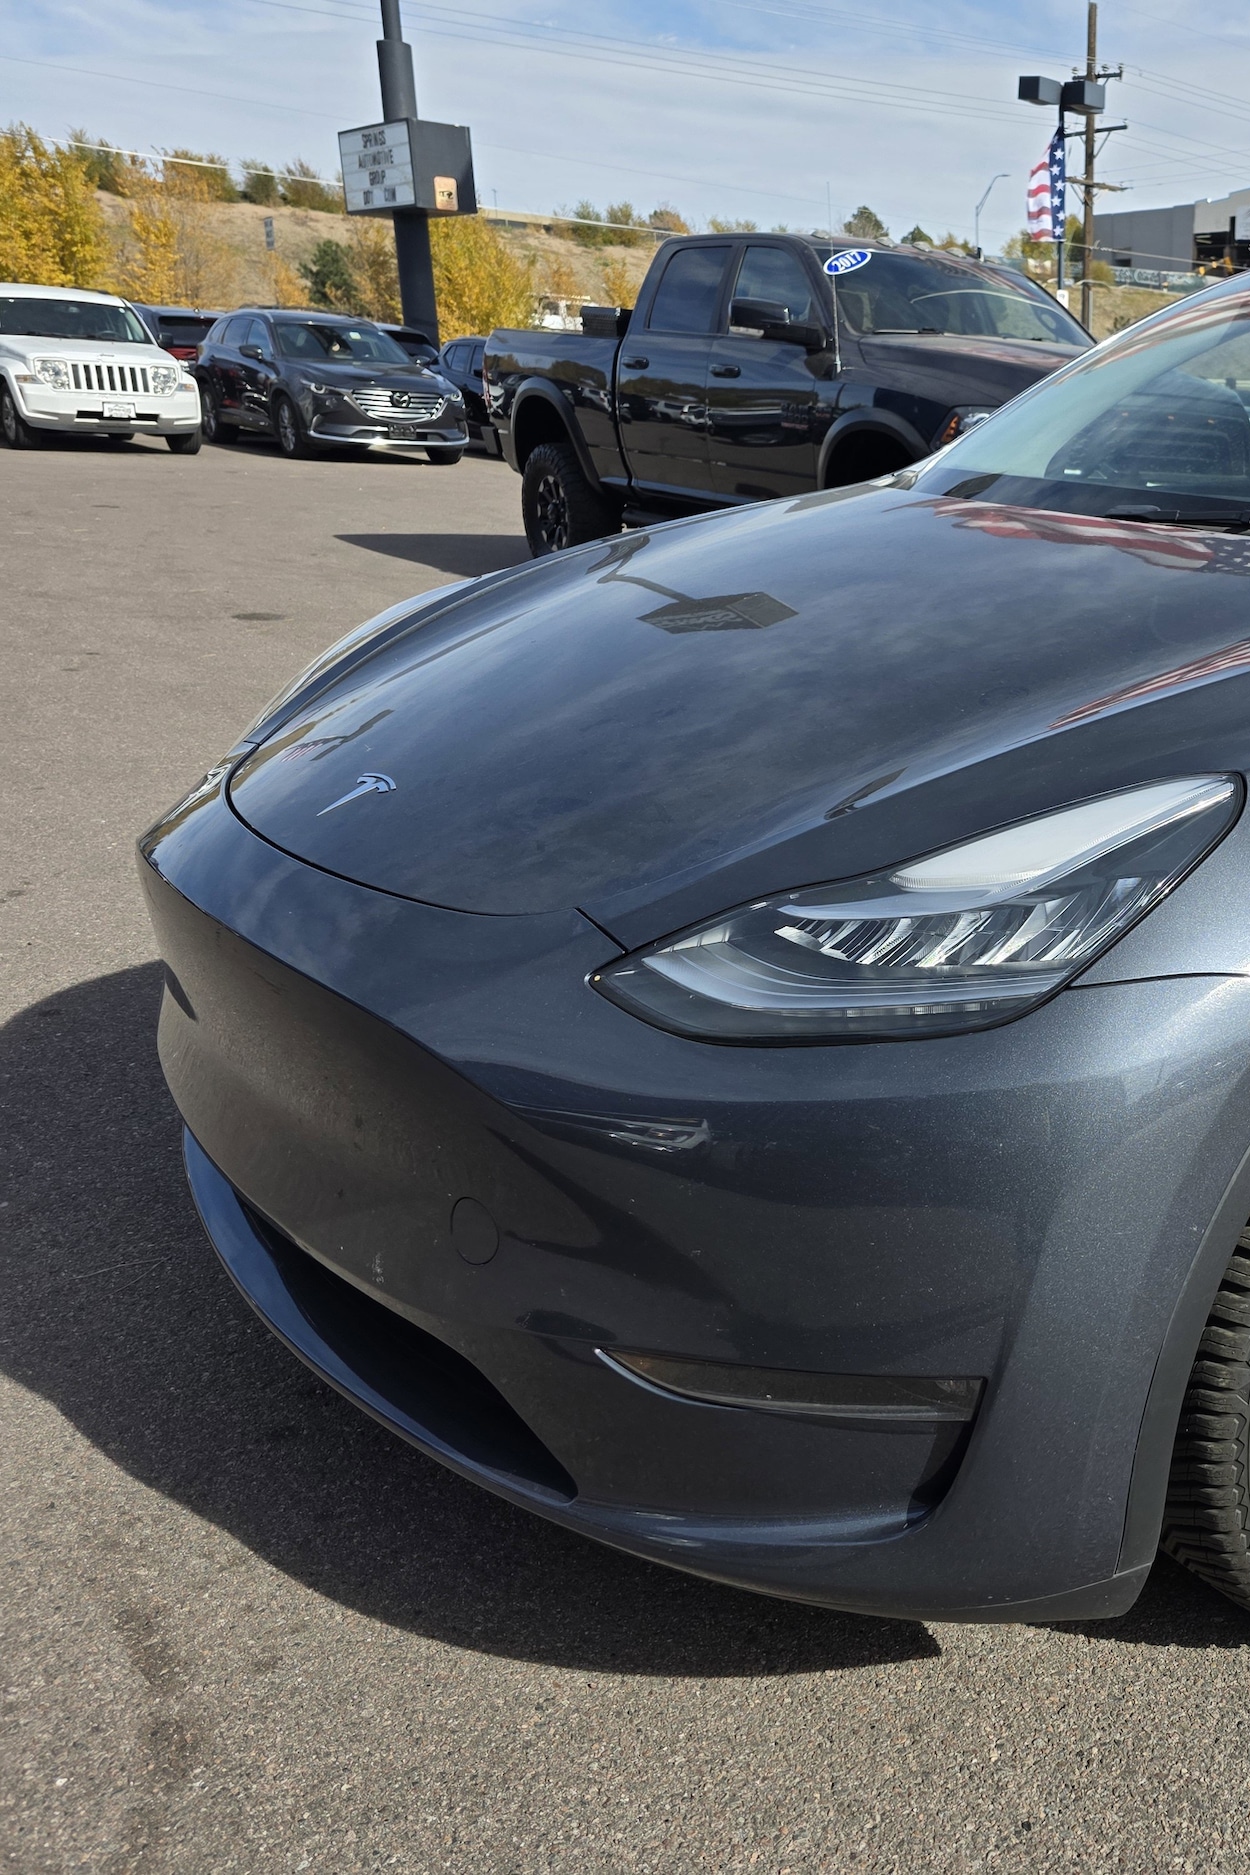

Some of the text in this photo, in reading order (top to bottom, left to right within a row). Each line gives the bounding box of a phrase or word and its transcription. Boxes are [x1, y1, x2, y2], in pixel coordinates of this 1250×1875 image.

[362, 130, 386, 148] SPRINGS
[358, 149, 394, 169] AUTOMOTIVE
[369, 170, 385, 185] GROUP
[832, 251, 861, 271] 2017
